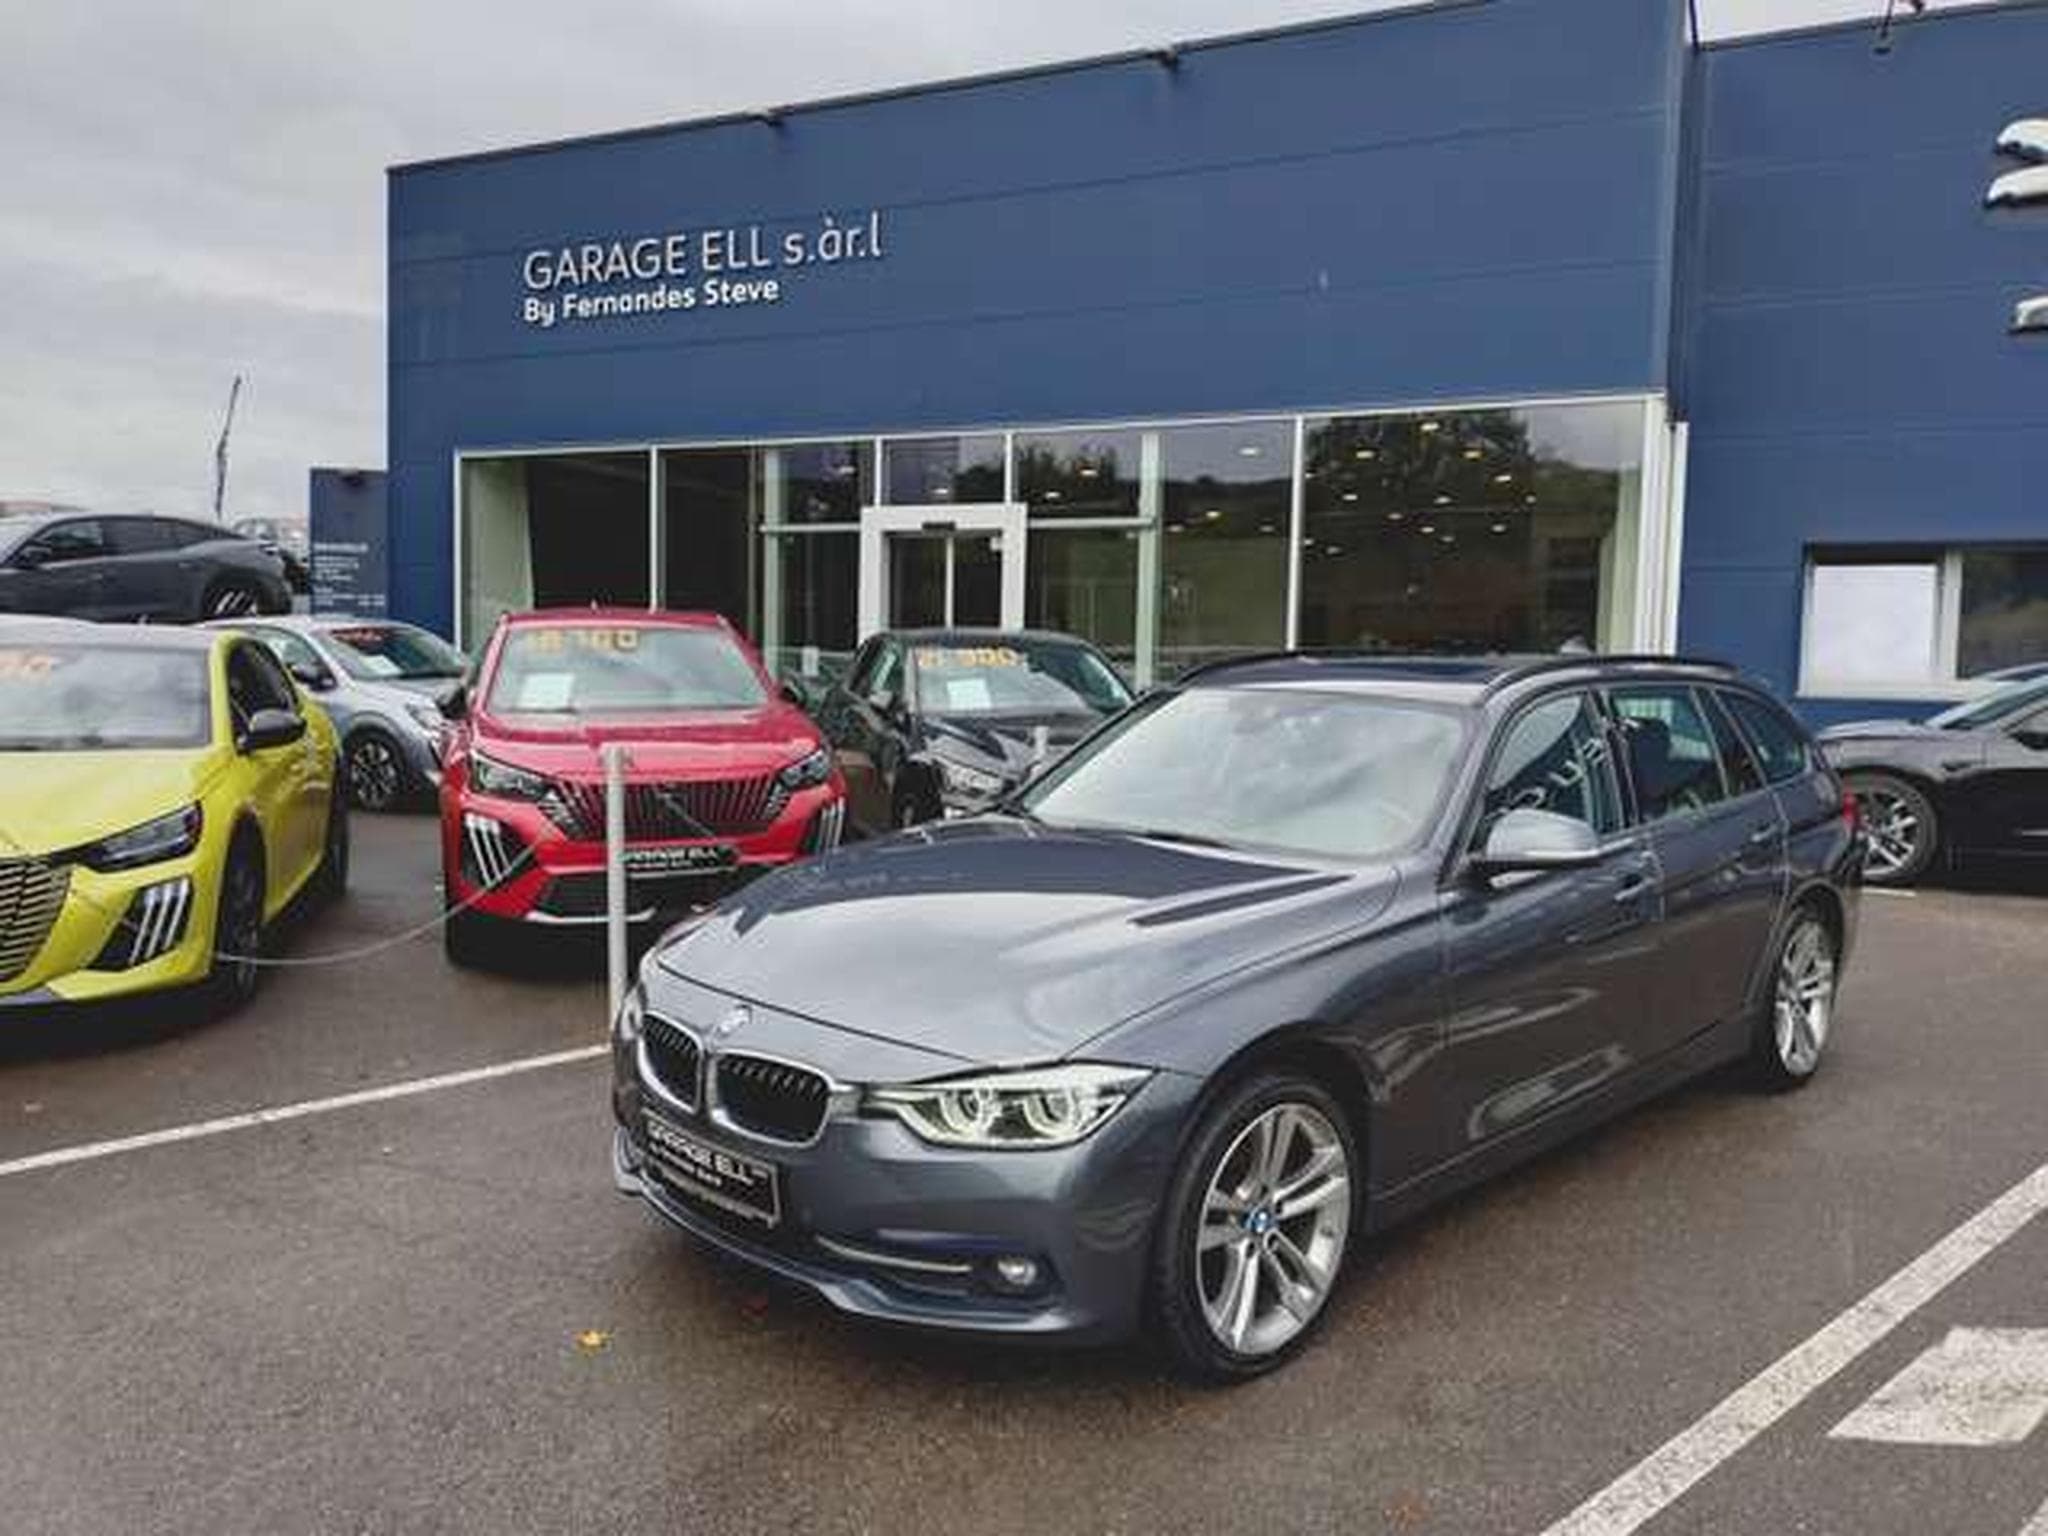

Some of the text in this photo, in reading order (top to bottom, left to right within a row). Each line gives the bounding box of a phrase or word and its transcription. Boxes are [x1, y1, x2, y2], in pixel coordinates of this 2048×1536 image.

[523, 235, 687, 289] GARAGE
[702, 227, 770, 271] ELL
[524, 277, 779, 327] By Fernandes Steve
